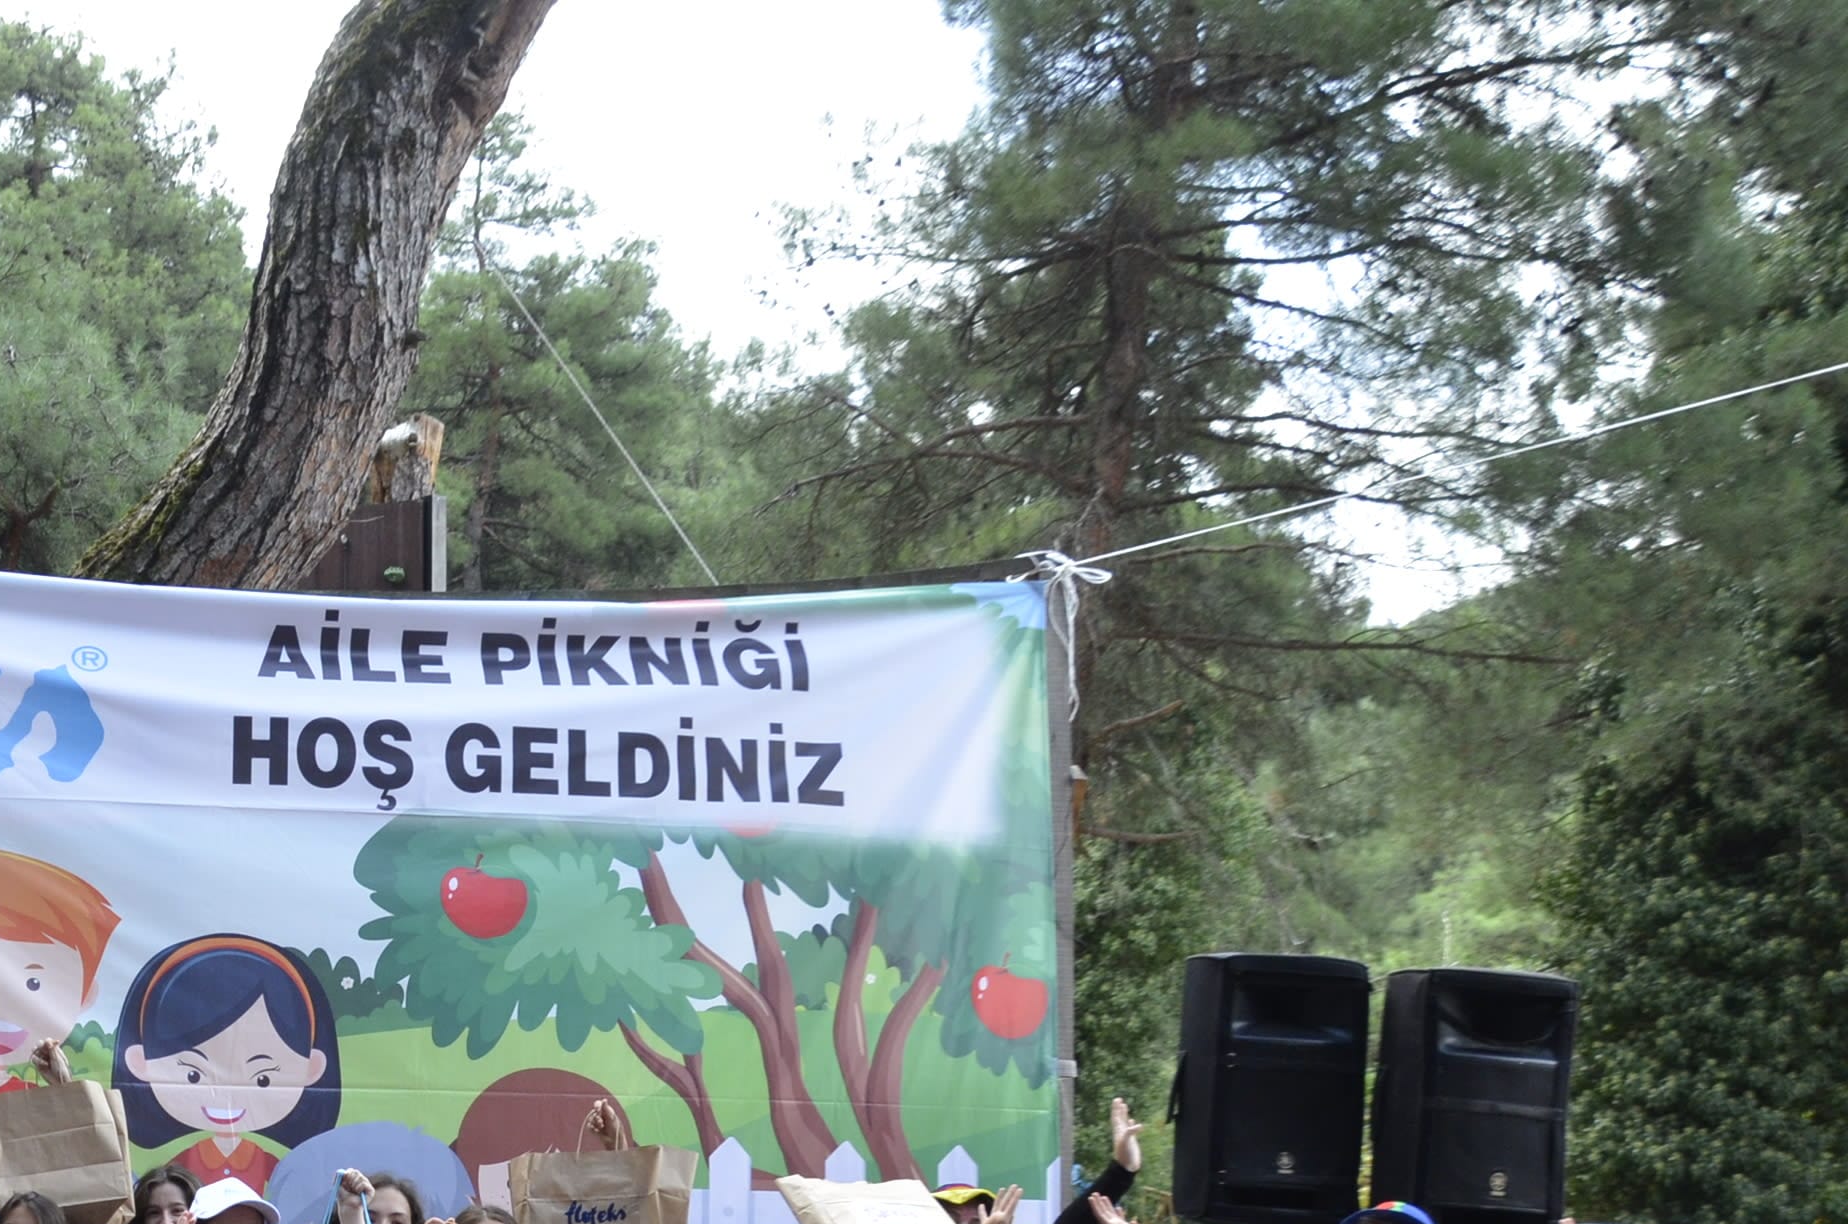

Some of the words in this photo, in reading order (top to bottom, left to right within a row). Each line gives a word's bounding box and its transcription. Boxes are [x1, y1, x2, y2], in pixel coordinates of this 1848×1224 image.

[258, 608, 451, 684] AİLE
[481, 617, 811, 692] PİKNİĞİ
[231, 715, 415, 811] HOŞ
[445, 716, 845, 807] GELDİNİZ
